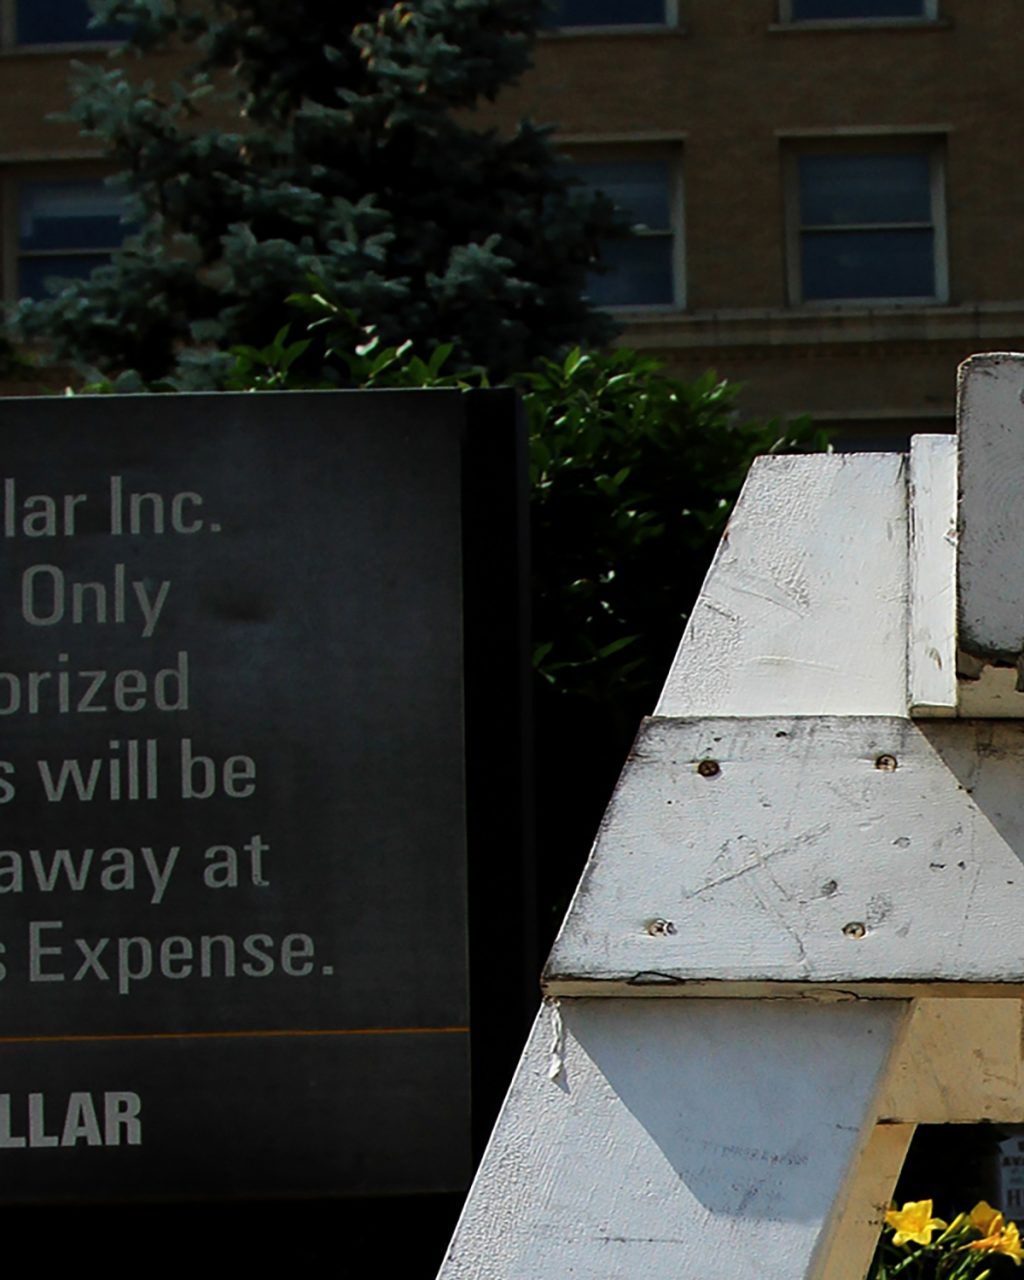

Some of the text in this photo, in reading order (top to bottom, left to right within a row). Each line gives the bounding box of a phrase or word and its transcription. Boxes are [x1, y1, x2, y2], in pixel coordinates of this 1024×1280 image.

[109, 475, 222, 535] Inc.
[21, 563, 171, 638] Only
[37, 739, 157, 802] will
[180, 738, 257, 799] be
[0, 835, 271, 904] away at
[28, 921, 335, 995] Expense.
